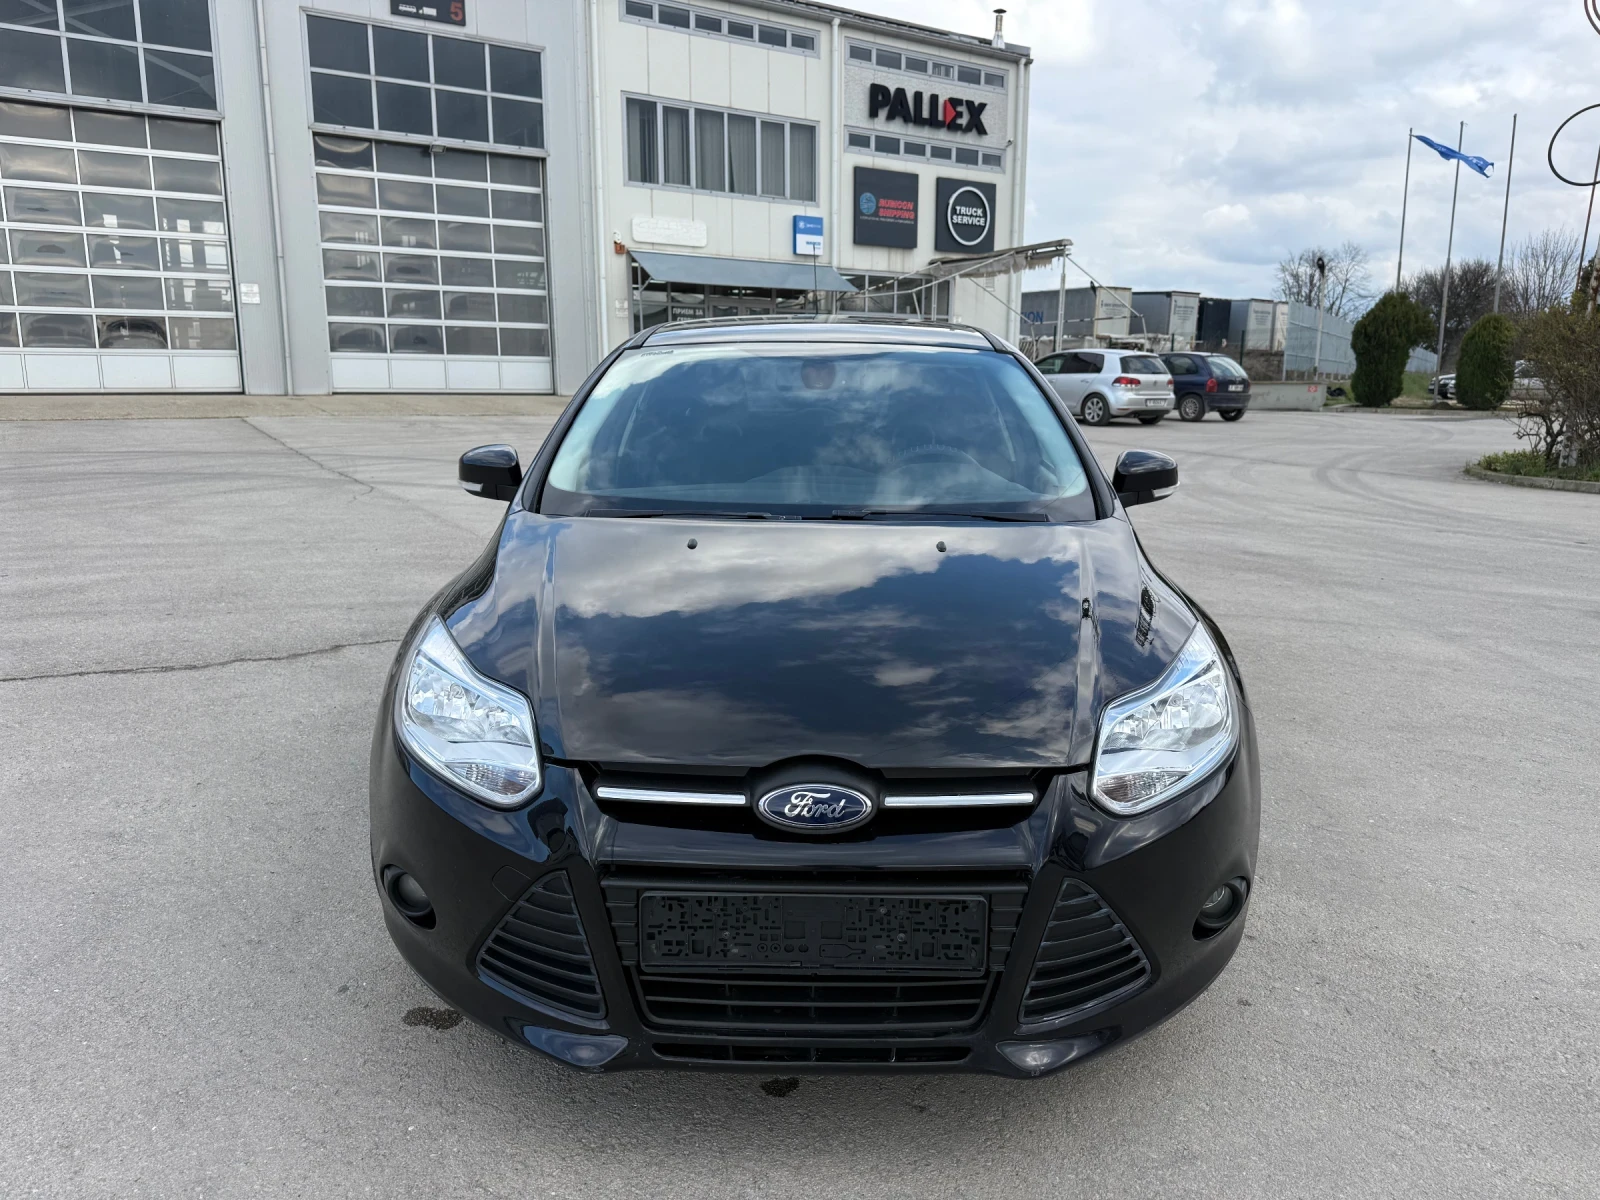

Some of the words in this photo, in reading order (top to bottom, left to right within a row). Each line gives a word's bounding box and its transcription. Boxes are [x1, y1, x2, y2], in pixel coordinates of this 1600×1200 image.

[450, 1, 463, 21] 5
[869, 83, 988, 135] PALLEX
[878, 199, 914, 210] RUBICON
[878, 208, 915, 220] SHIPPING
[955, 206, 983, 217] TRUCK
[952, 215, 985, 226] SERVICE
[784, 791, 846, 818] Ford
